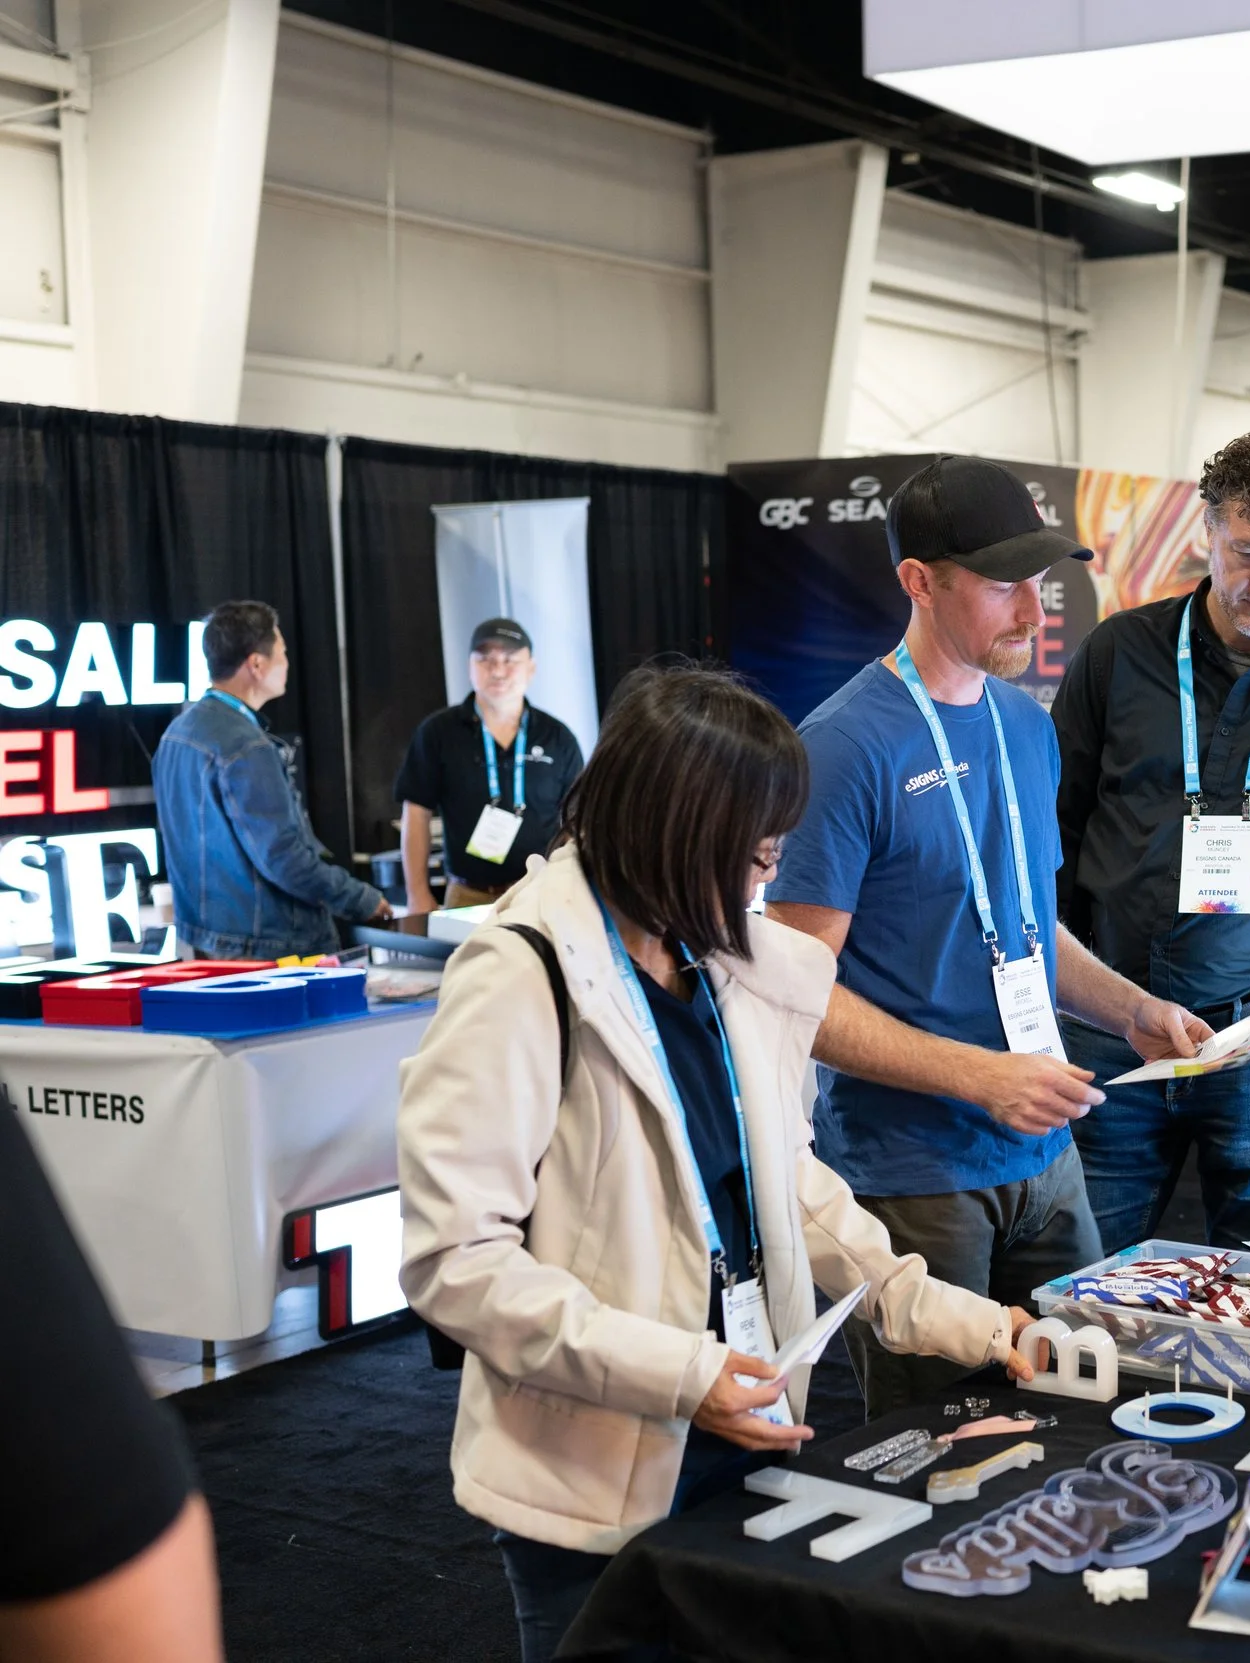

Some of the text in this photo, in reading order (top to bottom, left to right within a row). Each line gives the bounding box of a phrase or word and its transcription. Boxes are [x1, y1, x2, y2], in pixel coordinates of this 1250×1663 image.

[759, 498, 813, 530] GBC
[827, 498, 889, 523] SEA
[1040, 581, 1064, 611] HE
[905, 769, 940, 793] eSIGNS
[1206, 839, 1233, 847] CHRIS
[1014, 986, 1032, 1000] JESSE
[28, 1086, 145, 1124] LETTERS
